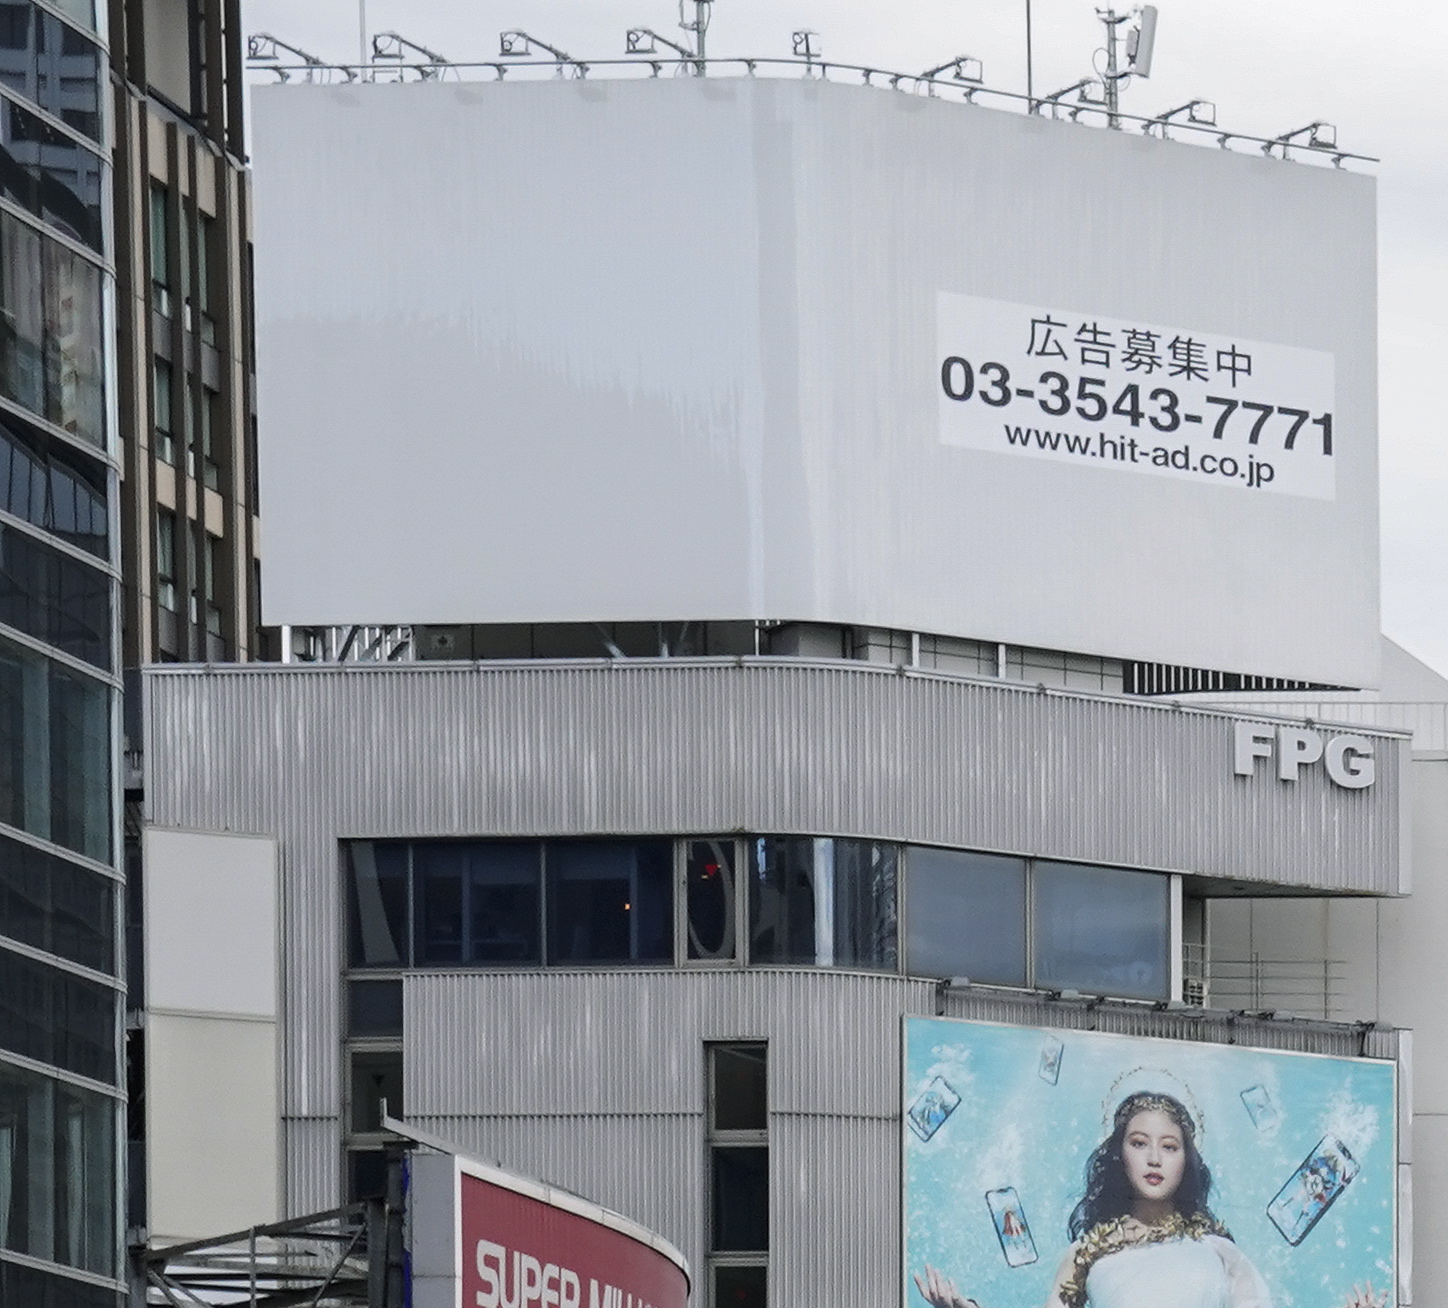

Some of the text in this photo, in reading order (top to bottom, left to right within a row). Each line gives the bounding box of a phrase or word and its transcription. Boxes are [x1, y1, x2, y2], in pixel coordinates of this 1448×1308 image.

[1026, 313, 1255, 388] 広告募集中
[940, 354, 1336, 458] 03-3543-7771
[1004, 417, 1276, 489] www.hit-ad.co.jp
[1235, 722, 1376, 790] FPG
